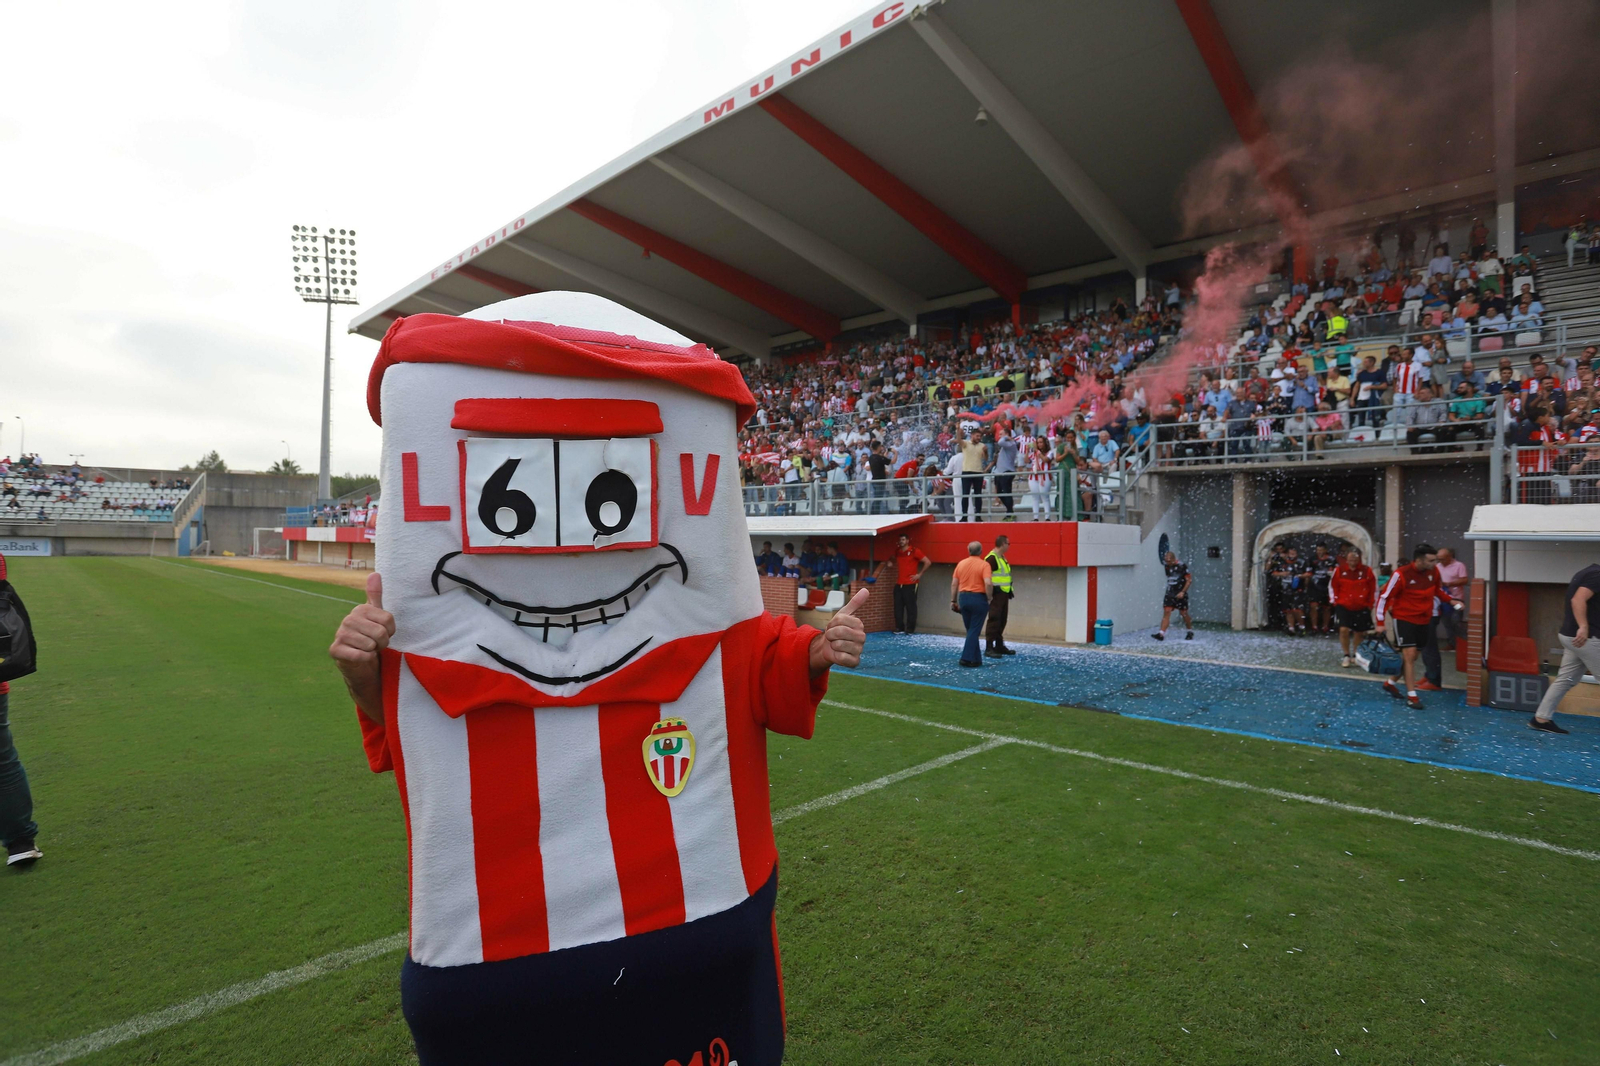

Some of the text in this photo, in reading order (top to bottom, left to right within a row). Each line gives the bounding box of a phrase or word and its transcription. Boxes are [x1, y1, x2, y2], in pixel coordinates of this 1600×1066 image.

[430, 1, 905, 281] ESTADIO MUNIC
[402, 451, 450, 522] L
[679, 453, 721, 515] V
